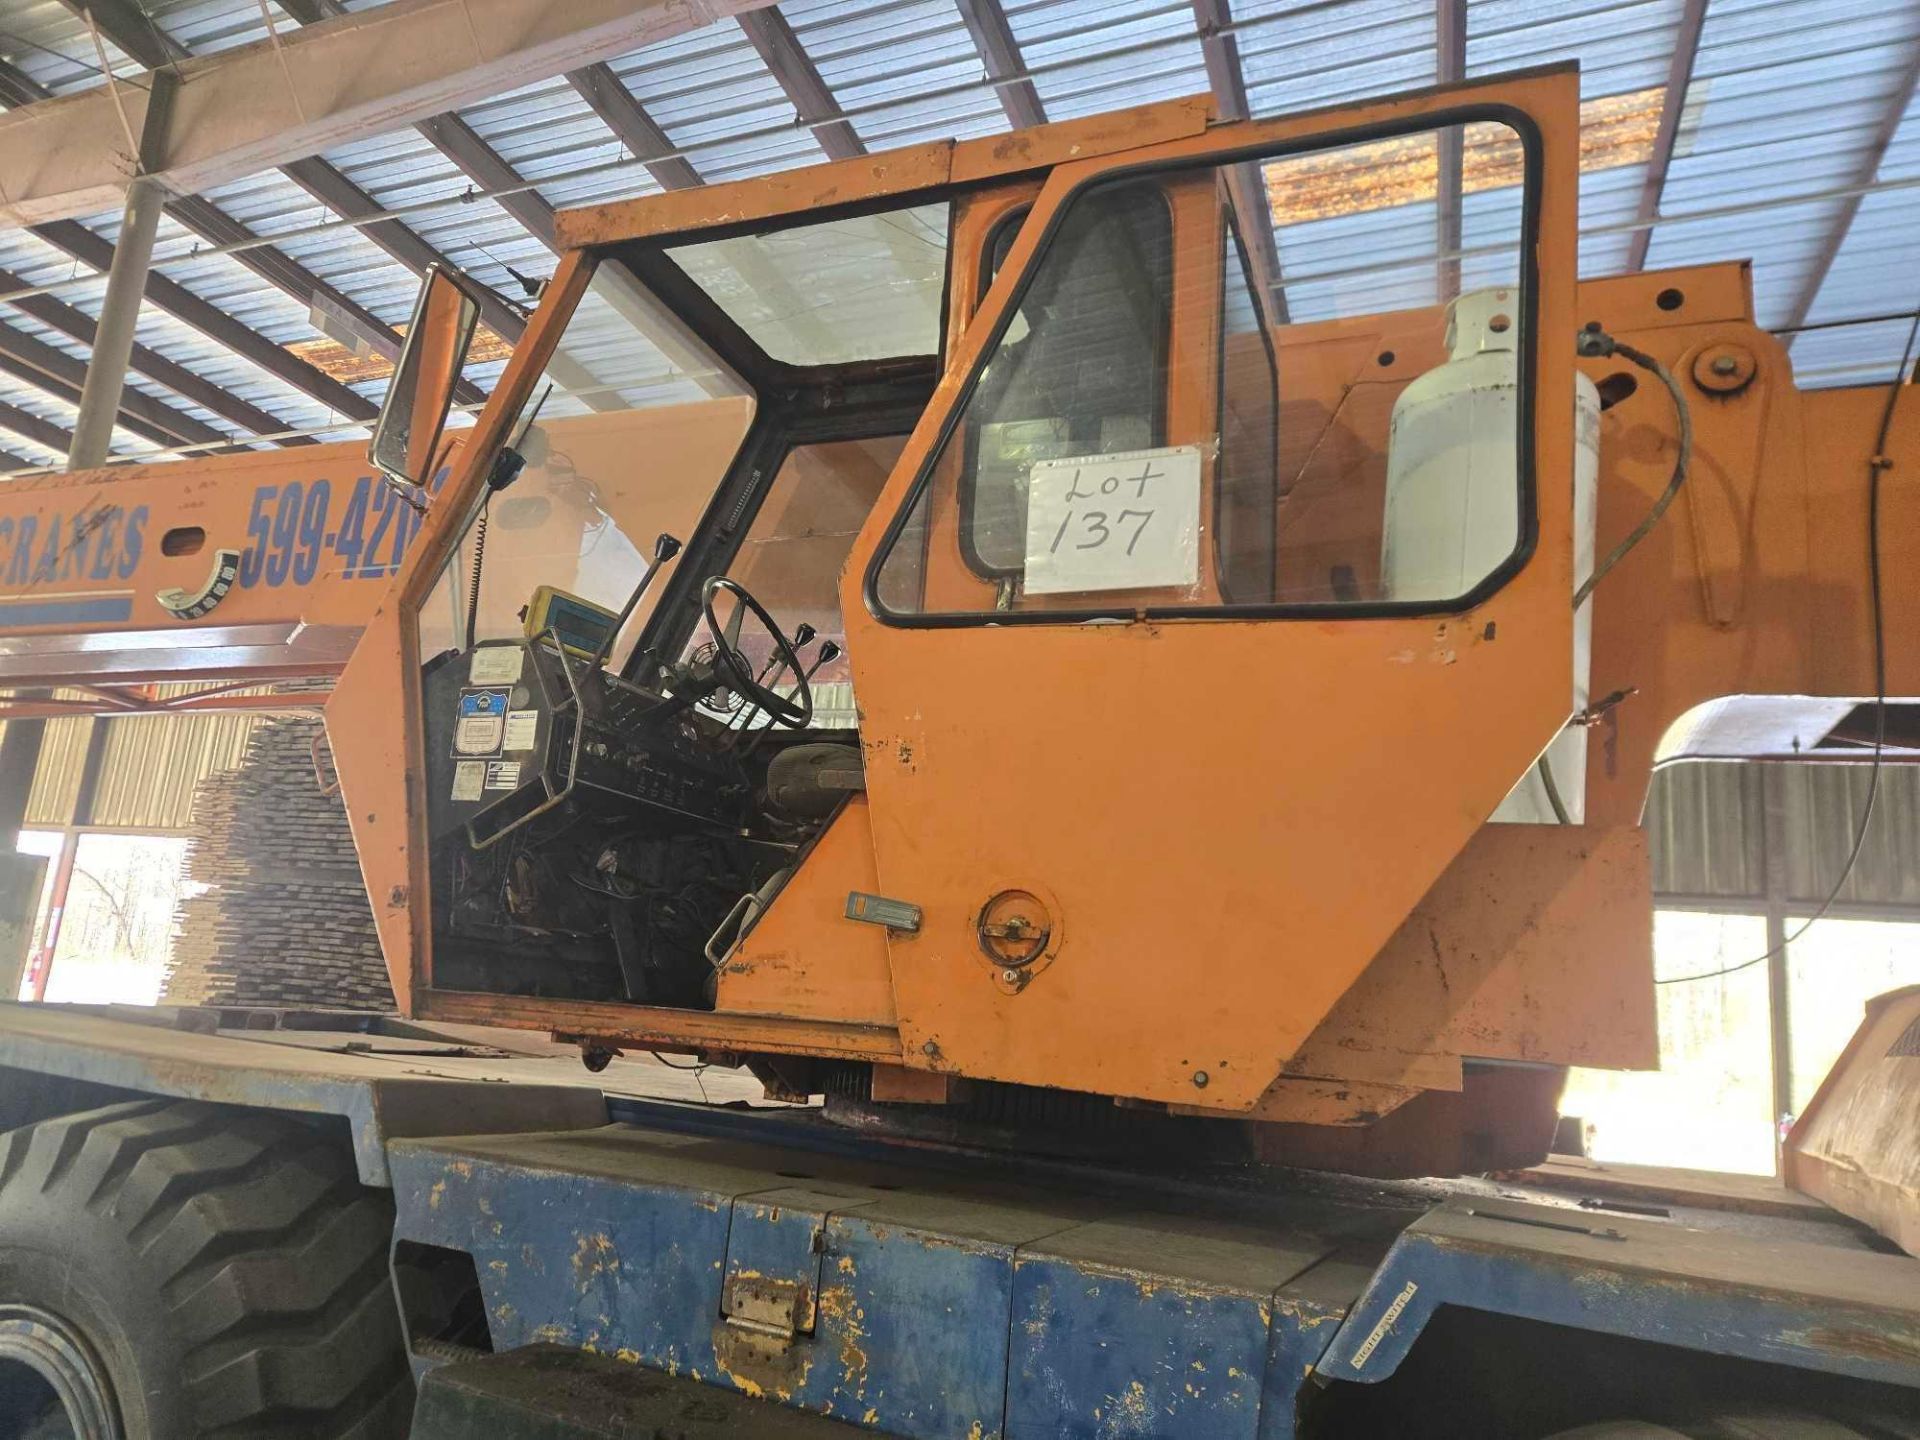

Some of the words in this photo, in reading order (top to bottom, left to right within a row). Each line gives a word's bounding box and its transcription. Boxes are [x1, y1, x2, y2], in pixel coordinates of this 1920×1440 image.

[1065, 462, 1165, 502] Lot
[239, 466, 452, 589] 599-420
[1050, 510, 1154, 556] 137
